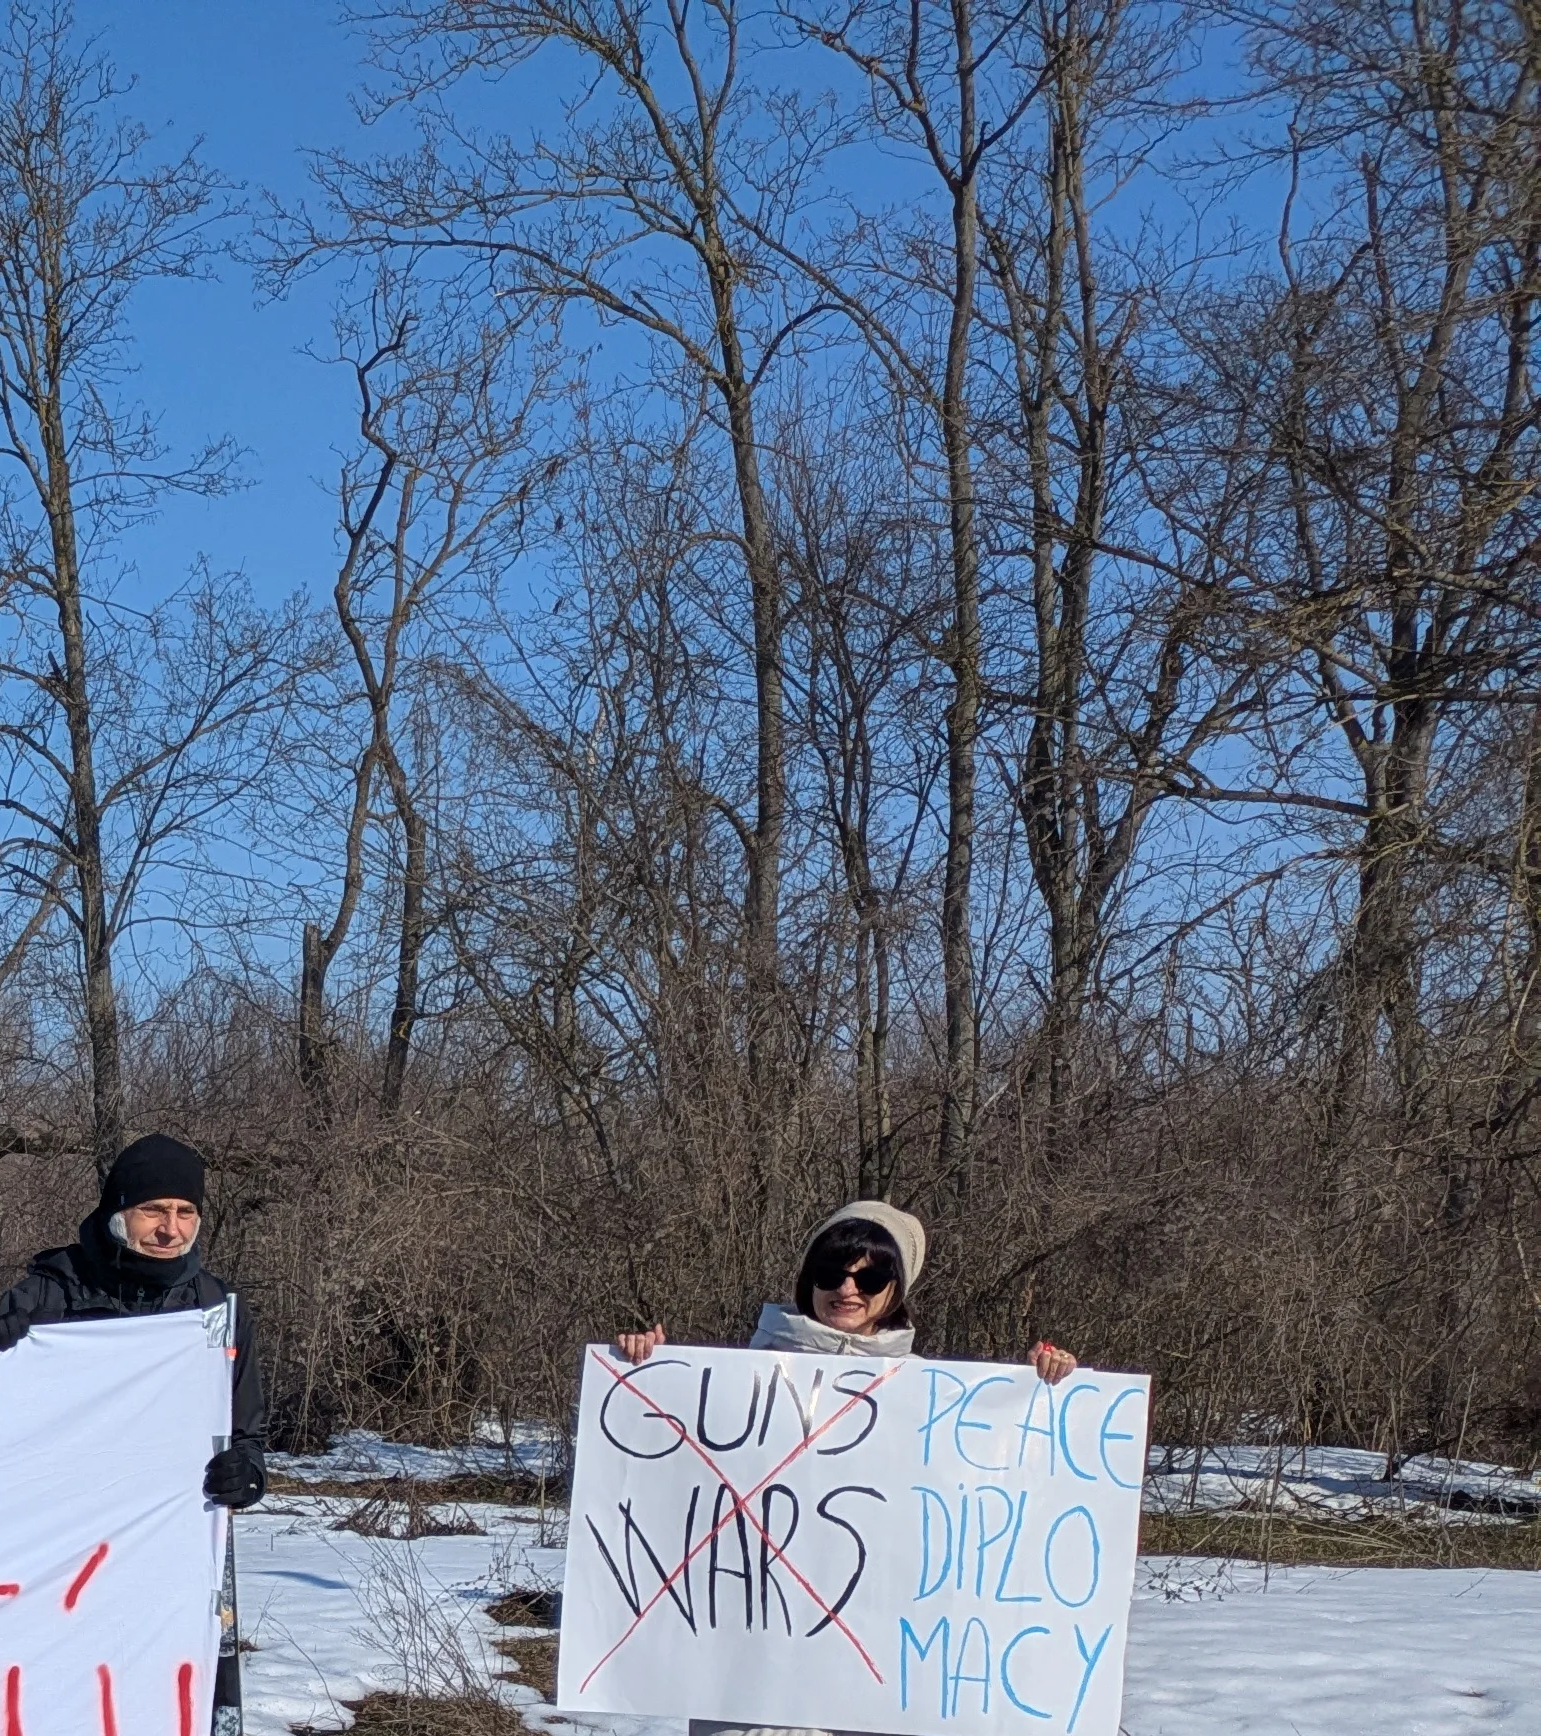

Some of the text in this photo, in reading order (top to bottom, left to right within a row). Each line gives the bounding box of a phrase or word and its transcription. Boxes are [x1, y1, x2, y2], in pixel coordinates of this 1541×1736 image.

[599, 1358, 879, 1460] GUNS
[918, 1368, 1148, 1489] PEACE
[585, 1483, 887, 1637] WARS
[898, 1615, 1114, 1735] MACY
